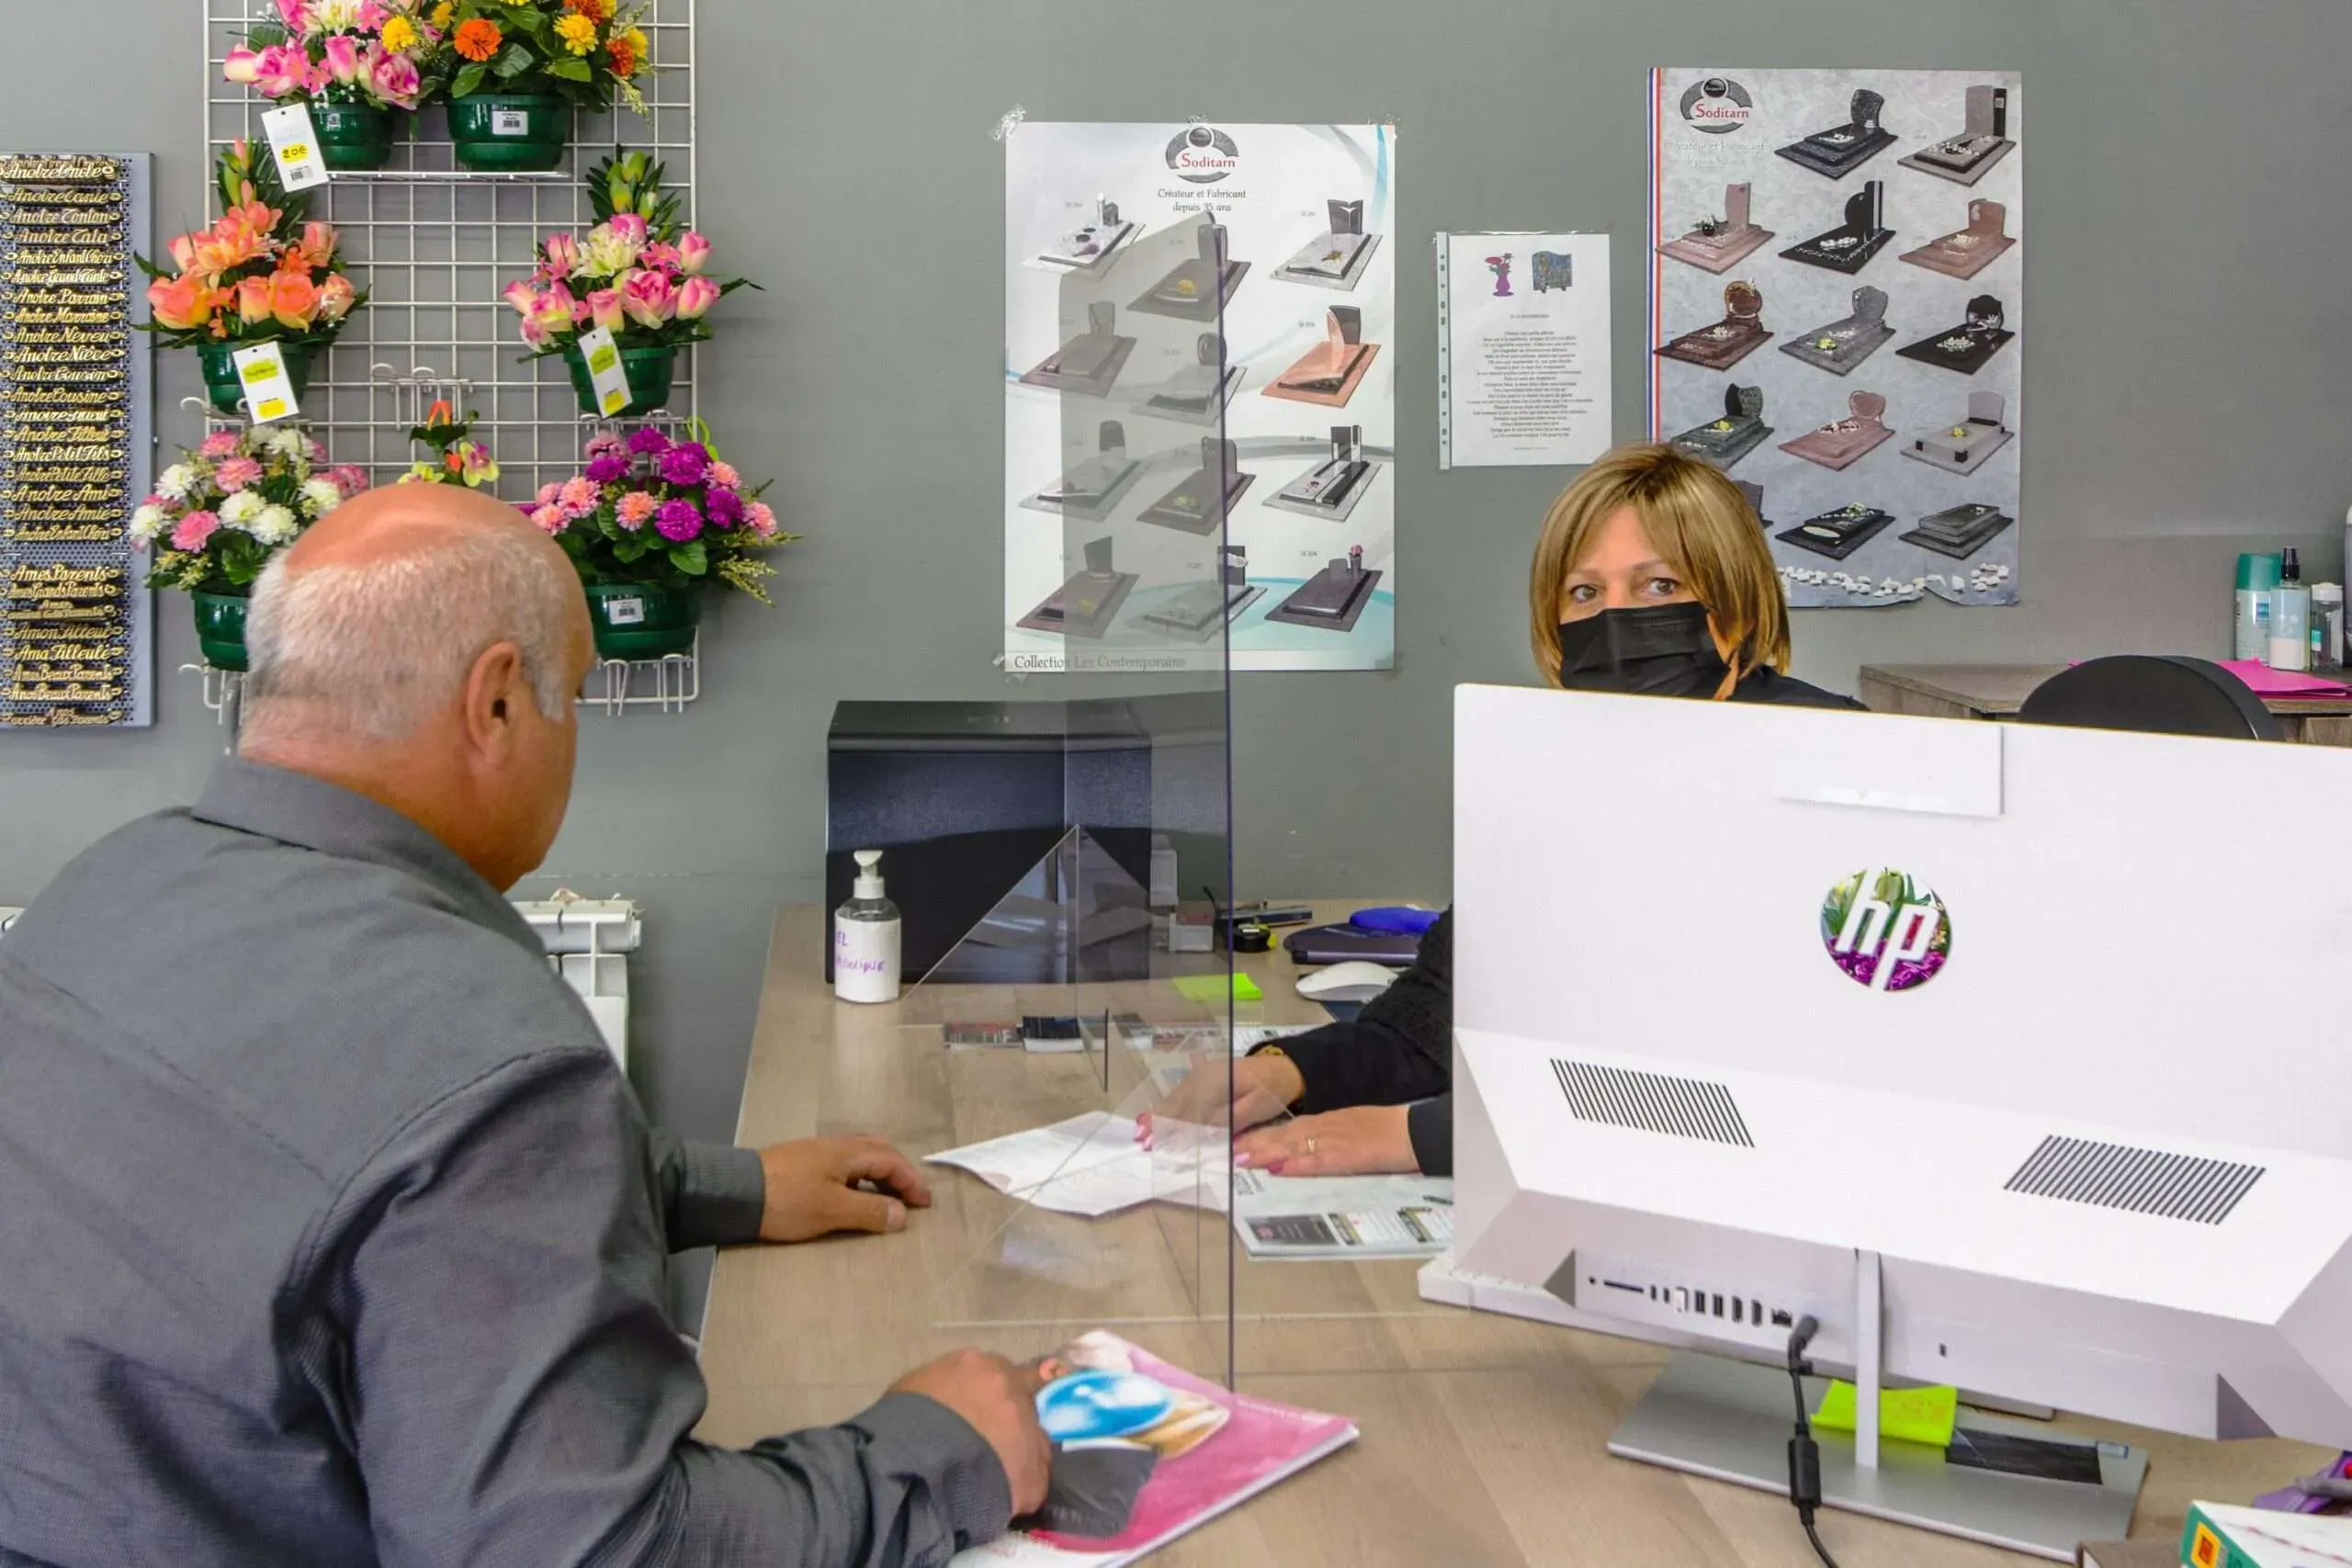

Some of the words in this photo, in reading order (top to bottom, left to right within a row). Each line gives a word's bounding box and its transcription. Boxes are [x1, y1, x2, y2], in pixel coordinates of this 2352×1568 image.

[1696, 104, 1749, 118] Soditarn
[1181, 152, 1236, 168] Soditarn
[1158, 188, 1193, 198] Créateur
[1197, 189, 1204, 198] et
[1207, 188, 1246, 198] Fabricant
[1173, 202, 1200, 213] depuis
[1014, 654, 1070, 669] Collection
[1074, 655, 1094, 669] Les
[1835, 868, 1939, 991] hp
